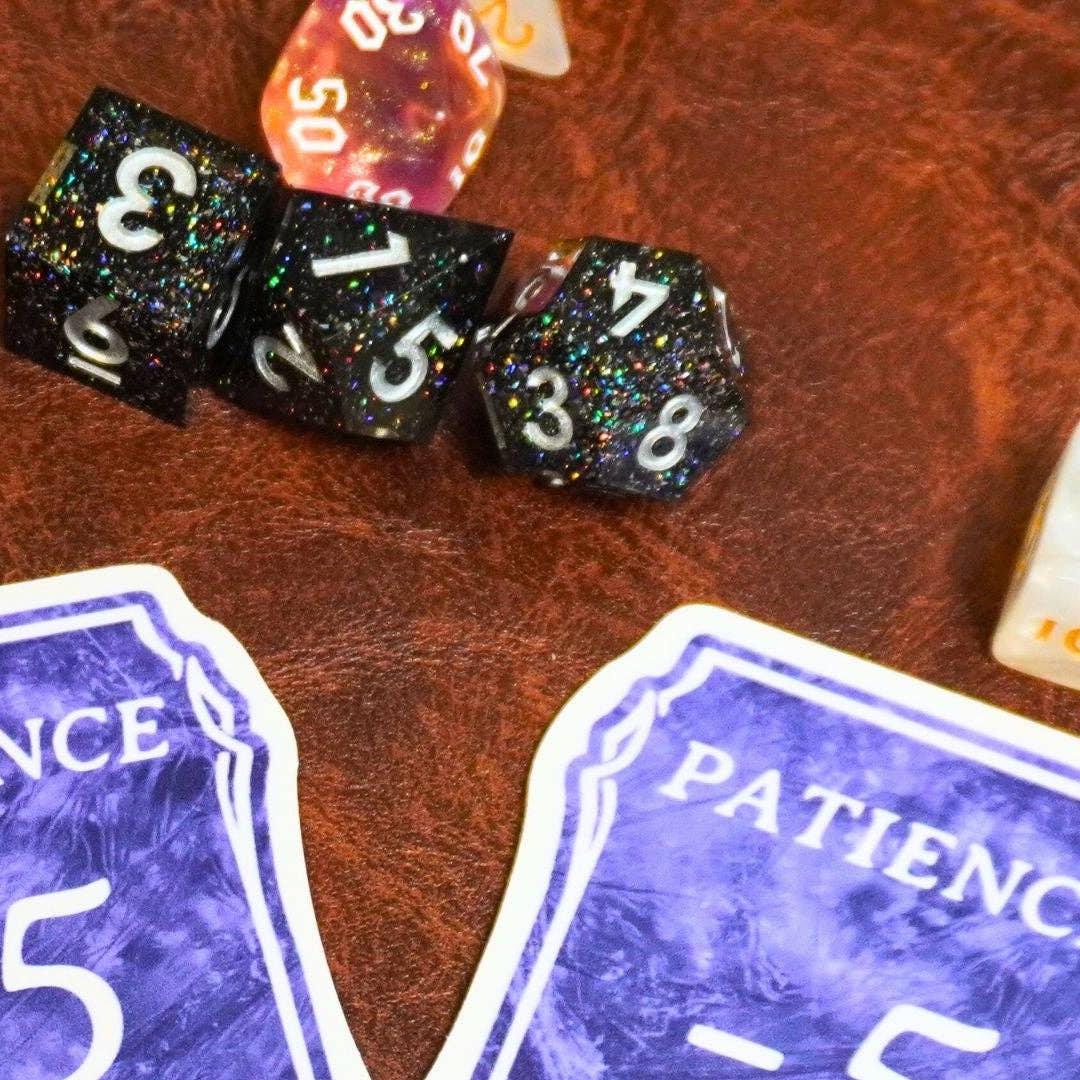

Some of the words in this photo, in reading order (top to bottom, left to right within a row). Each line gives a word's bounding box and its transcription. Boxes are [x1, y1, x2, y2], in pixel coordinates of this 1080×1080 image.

[287, 76, 348, 154] 50
[97, 146, 197, 252] 3
[609, 261, 670, 337] 4
[369, 310, 460, 402] 5
[523, 366, 573, 451] 3
[637, 393, 705, 471] 8
[659, 740, 1080, 940] PATIENC
